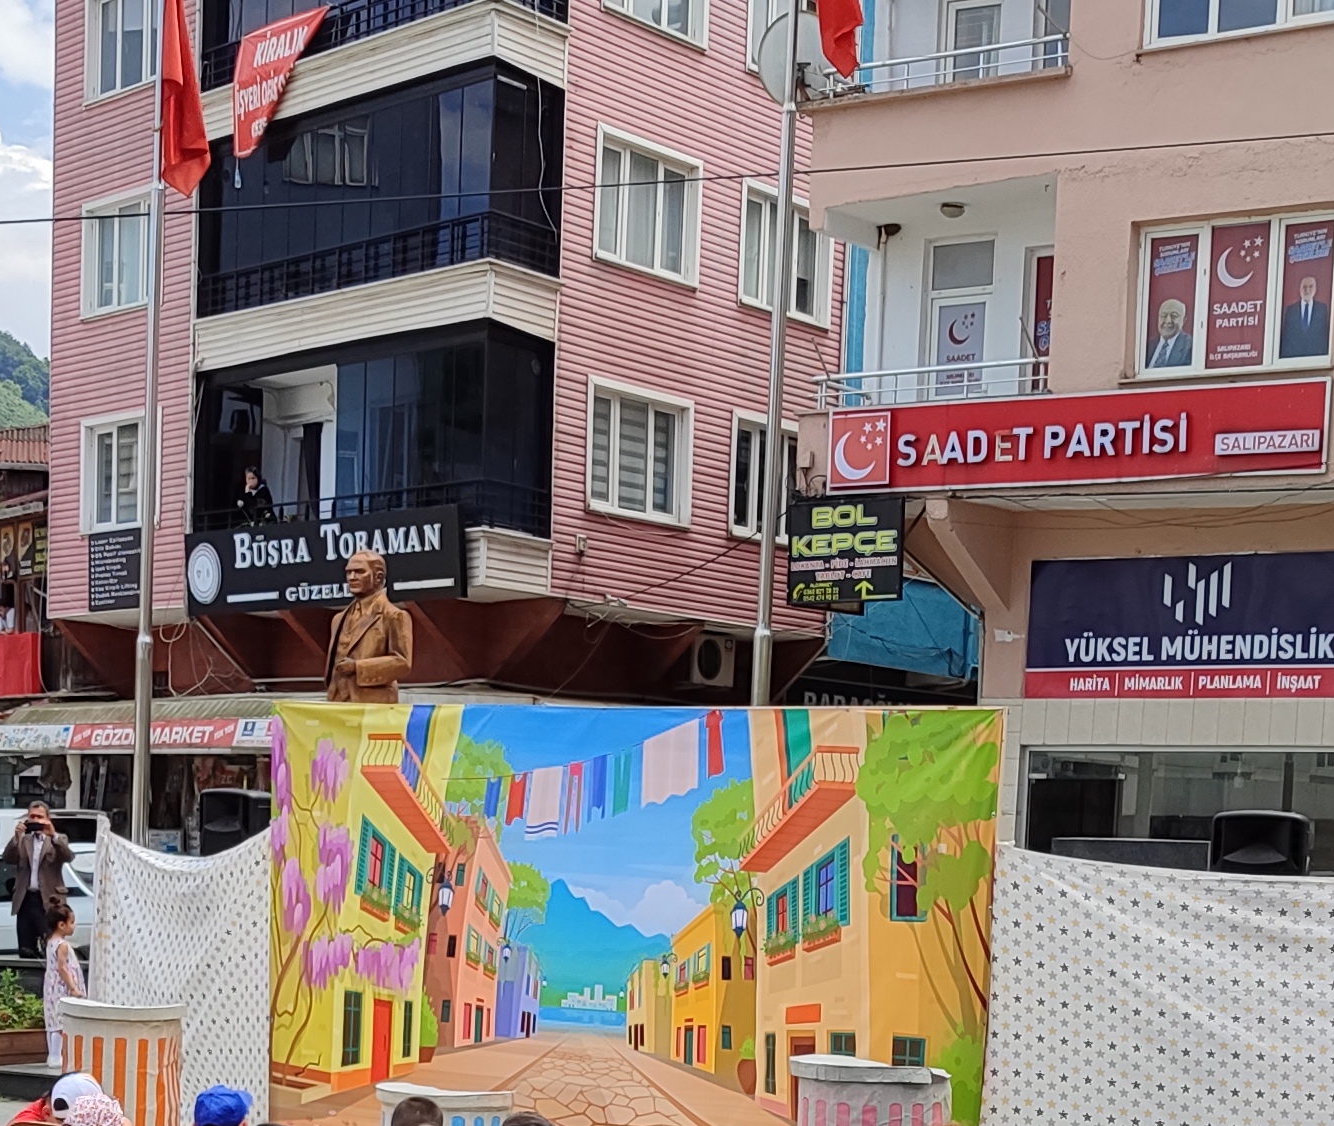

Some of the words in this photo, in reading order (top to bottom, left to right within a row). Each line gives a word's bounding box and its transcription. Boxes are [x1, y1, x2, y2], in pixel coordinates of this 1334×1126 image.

[253, 25, 309, 69] KİRALIK
[1213, 300, 1263, 315] SAADET
[1216, 315, 1259, 328] PARTİSİ
[946, 353, 976, 363] SAADET
[897, 426, 1034, 466] SAADET
[1043, 412, 1188, 460] PARTİSİ
[1219, 432, 1316, 452] SALIPAZARI
[811, 504, 878, 529] BOL
[233, 532, 312, 569] BÜŞRA
[320, 523, 442, 561] TORAMAN
[791, 530, 898, 558] KEPÇE
[285, 582, 353, 602] GÜZELL
[1065, 631, 1155, 663] YÜKSEL
[1069, 674, 1110, 692] HARİTA
[1124, 674, 1184, 691] MİMARLIK
[1198, 674, 1262, 690] PLANLAMA
[1276, 672, 1322, 694] İNŞAAT
[91, 725, 136, 746] GÖZD
[150, 725, 214, 744] MARKET
